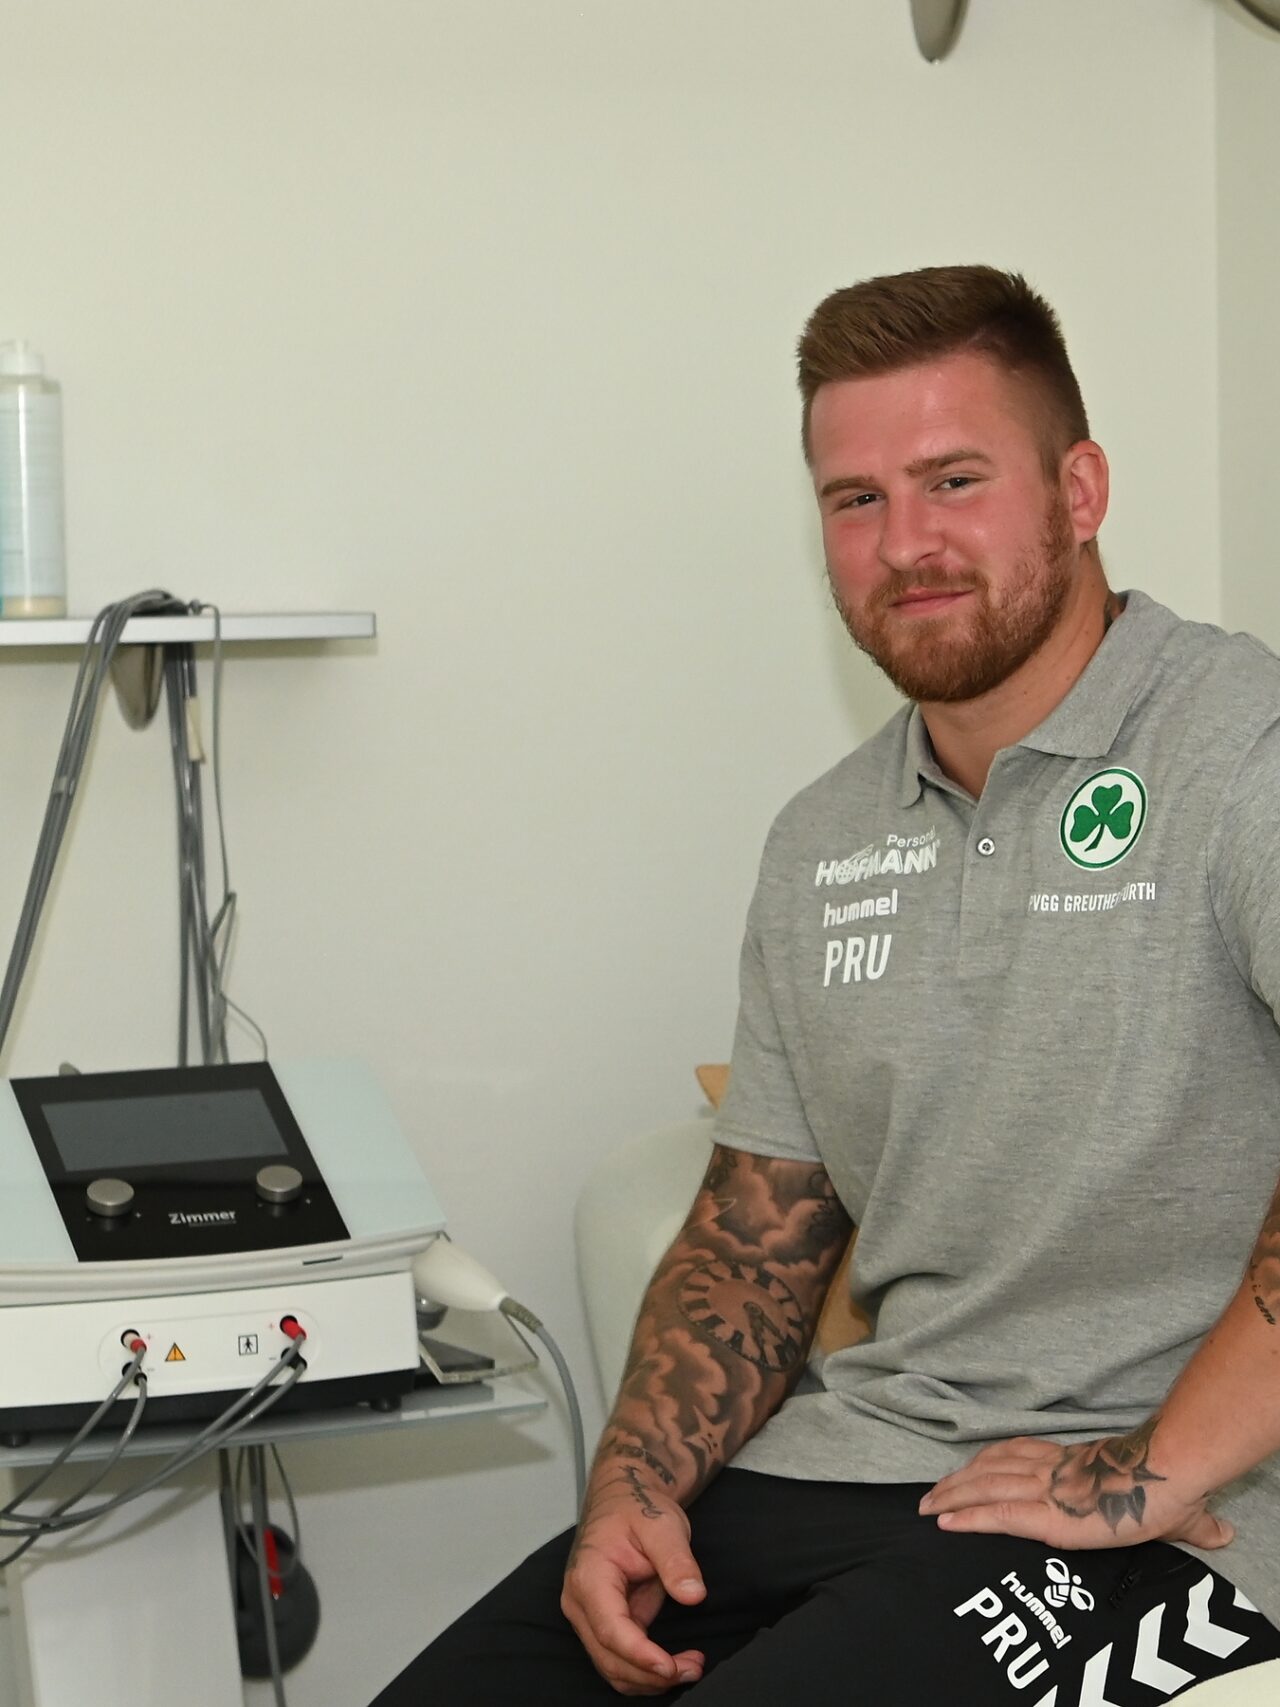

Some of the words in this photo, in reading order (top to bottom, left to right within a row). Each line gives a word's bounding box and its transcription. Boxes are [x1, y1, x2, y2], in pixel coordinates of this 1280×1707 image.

[823, 888, 898, 928] hummel
[823, 933, 893, 987] PRU
[167, 1210, 237, 1225] Zimmer
[1000, 1570, 1074, 1650] hummel
[952, 1586, 1050, 1691] PRU
